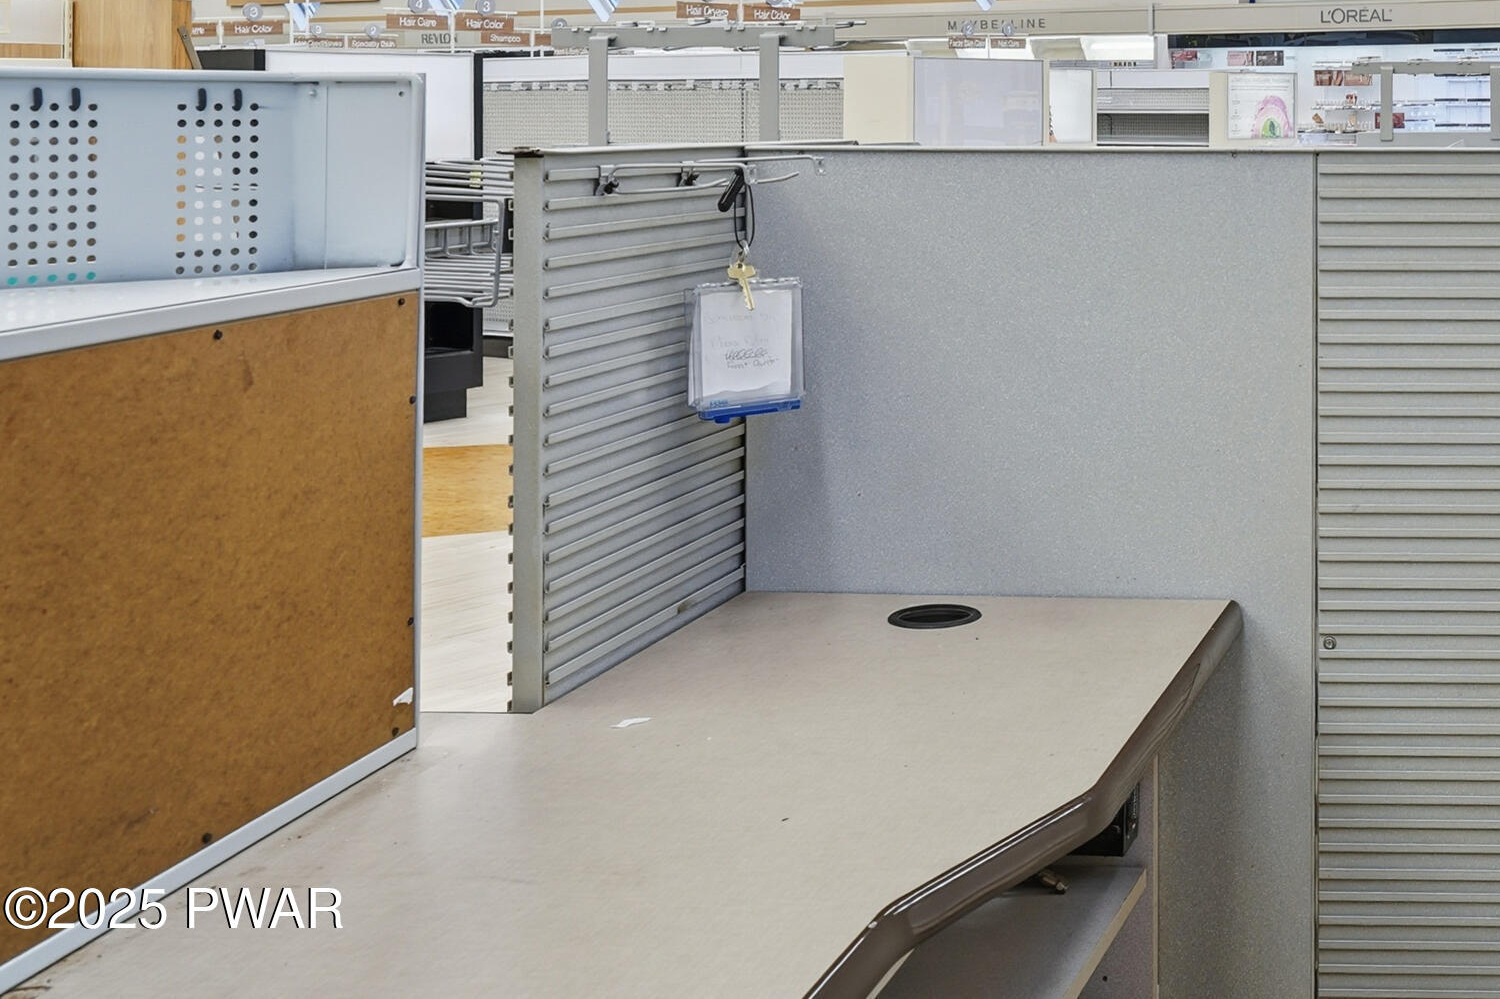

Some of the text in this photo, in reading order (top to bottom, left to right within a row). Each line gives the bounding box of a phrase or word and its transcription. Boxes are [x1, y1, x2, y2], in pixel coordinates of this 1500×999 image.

[482, 1, 490, 12] 3
[686, 4, 702, 16] Hair
[753, 9, 791, 20] Hair Color
[399, 16, 437, 27] Hair Care
[466, 18, 505, 29] Hair Color
[234, 24, 273, 34] Hair Color
